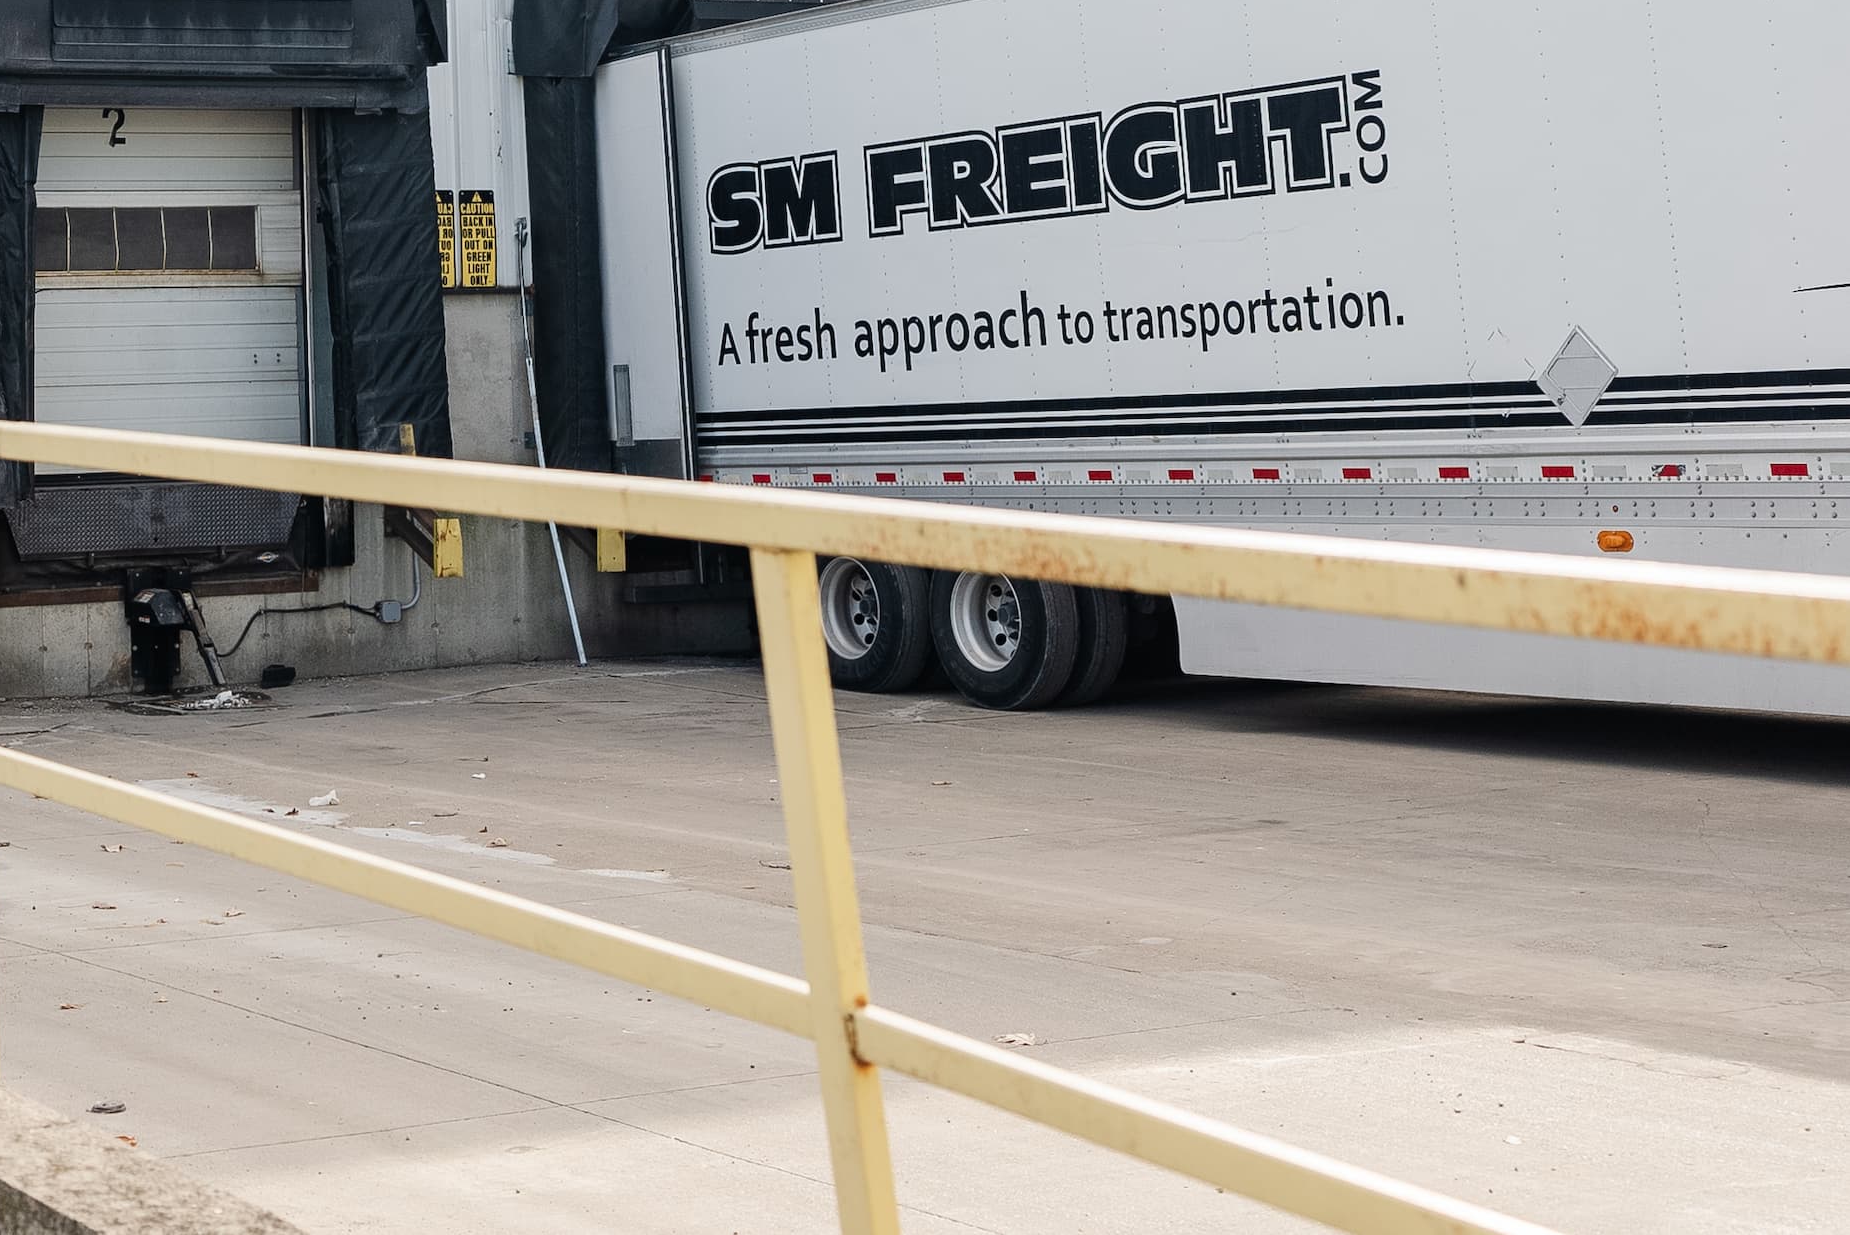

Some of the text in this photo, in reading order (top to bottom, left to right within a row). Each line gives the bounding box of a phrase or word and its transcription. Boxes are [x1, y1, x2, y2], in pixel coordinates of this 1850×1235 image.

[102, 107, 126, 148] 2
[707, 150, 842, 255] SM
[864, 75, 1350, 238] FREIGHT
[461, 203, 494, 214] CAUTION
[463, 217, 493, 227] BACK IN
[462, 228, 494, 238] OR PULL
[464, 240, 493, 250] OUT ON
[467, 252, 491, 262] GREEN
[468, 264, 490, 274] LIGHT
[470, 275, 488, 285] ONLY
[718, 278, 1405, 372] A fresh approach to transportation.
